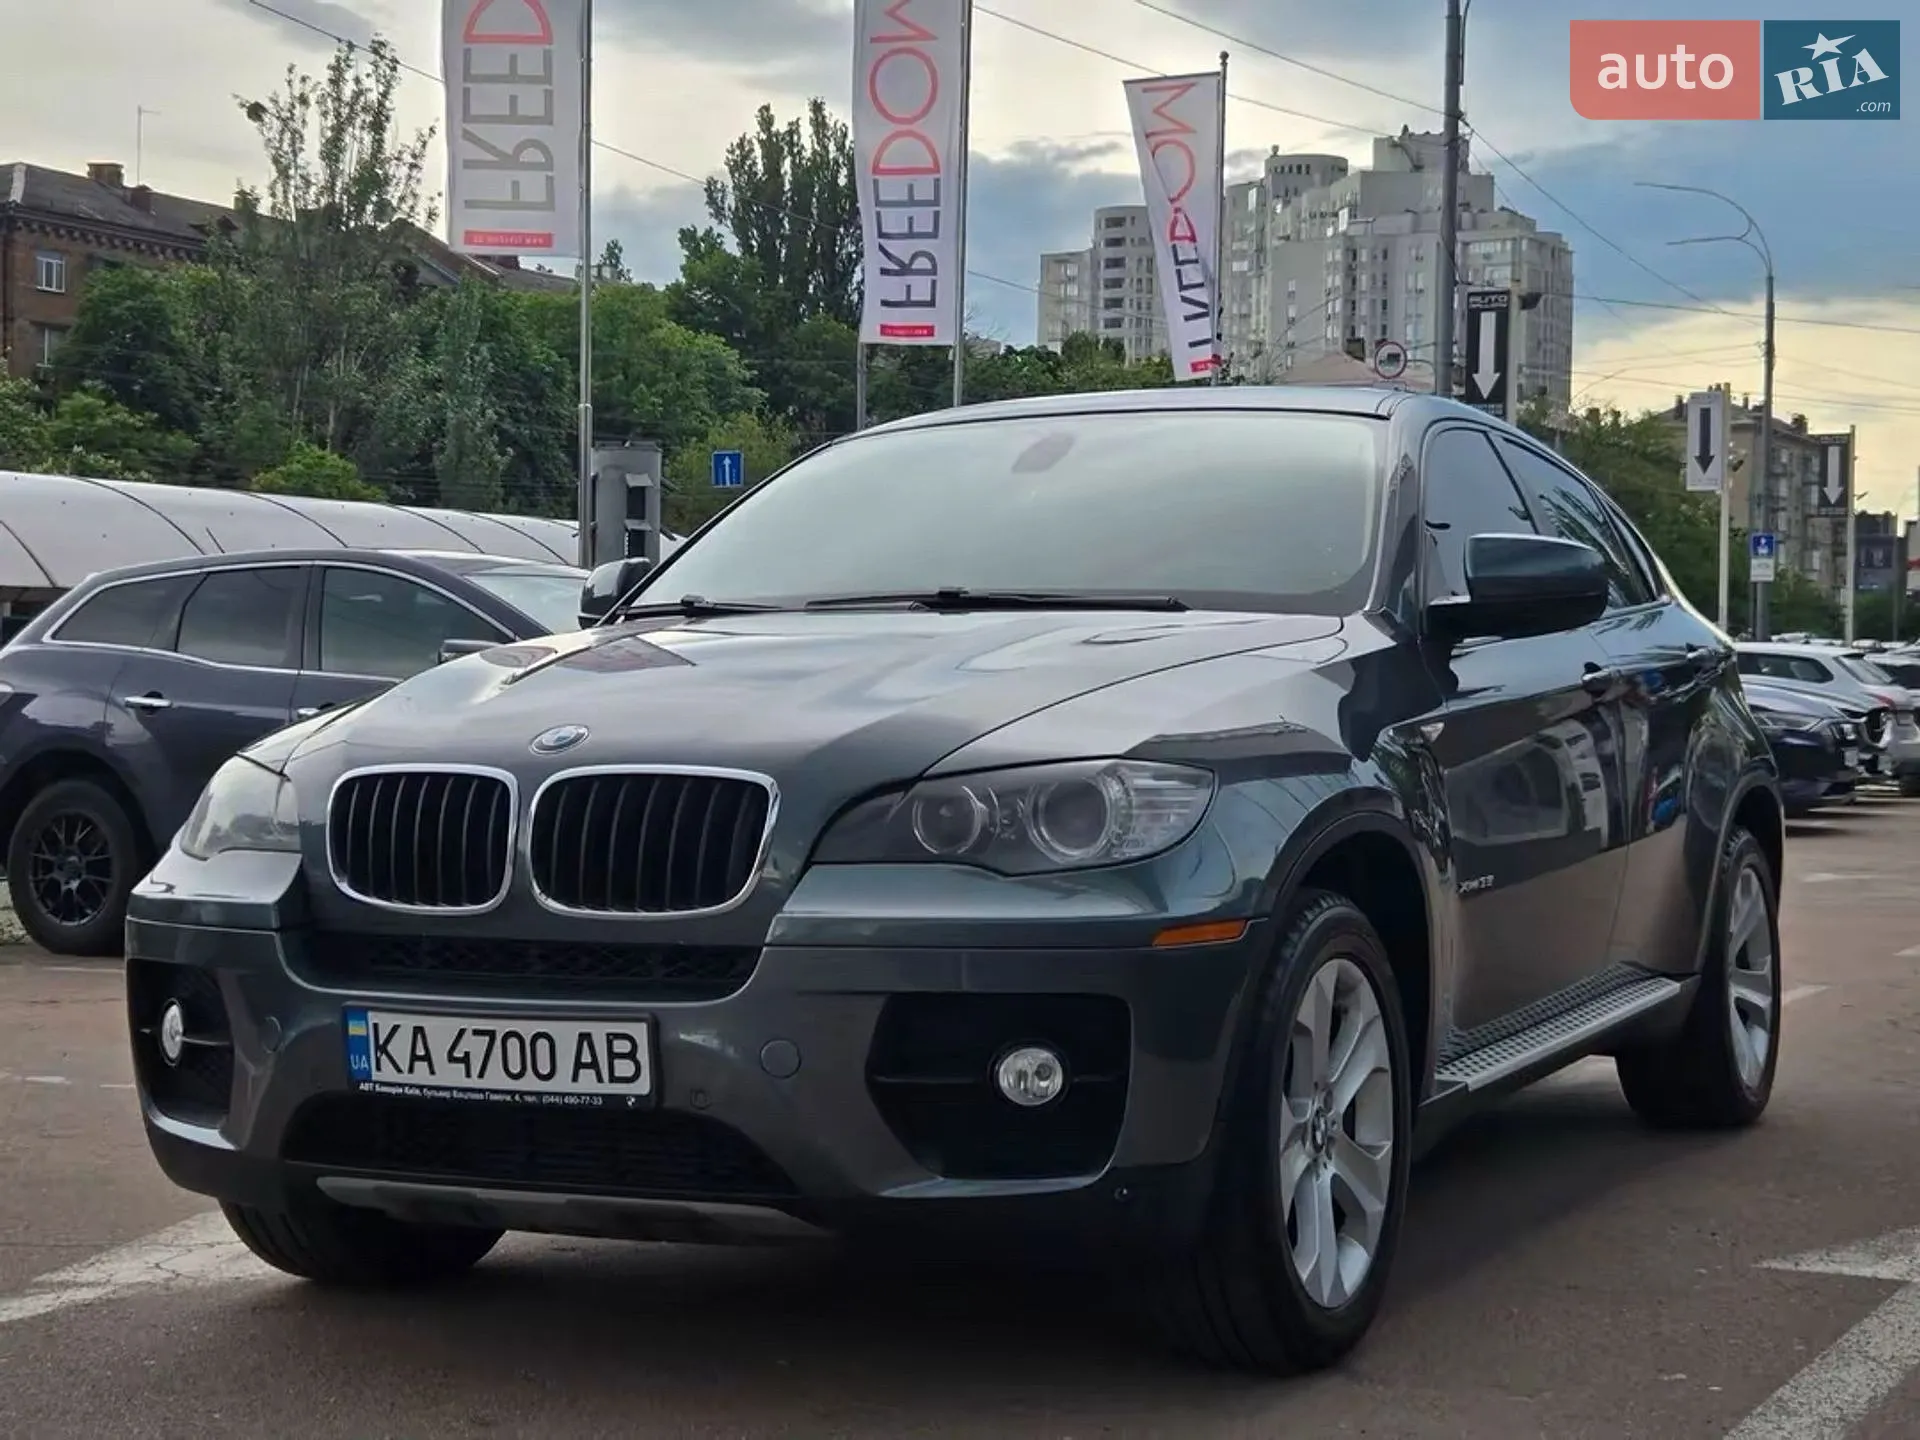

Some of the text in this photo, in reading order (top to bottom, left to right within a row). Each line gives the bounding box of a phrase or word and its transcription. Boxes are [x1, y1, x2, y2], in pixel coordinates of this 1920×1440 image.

[350, 1053, 369, 1071] UA
[372, 1021, 642, 1084] KA 4700 AB
